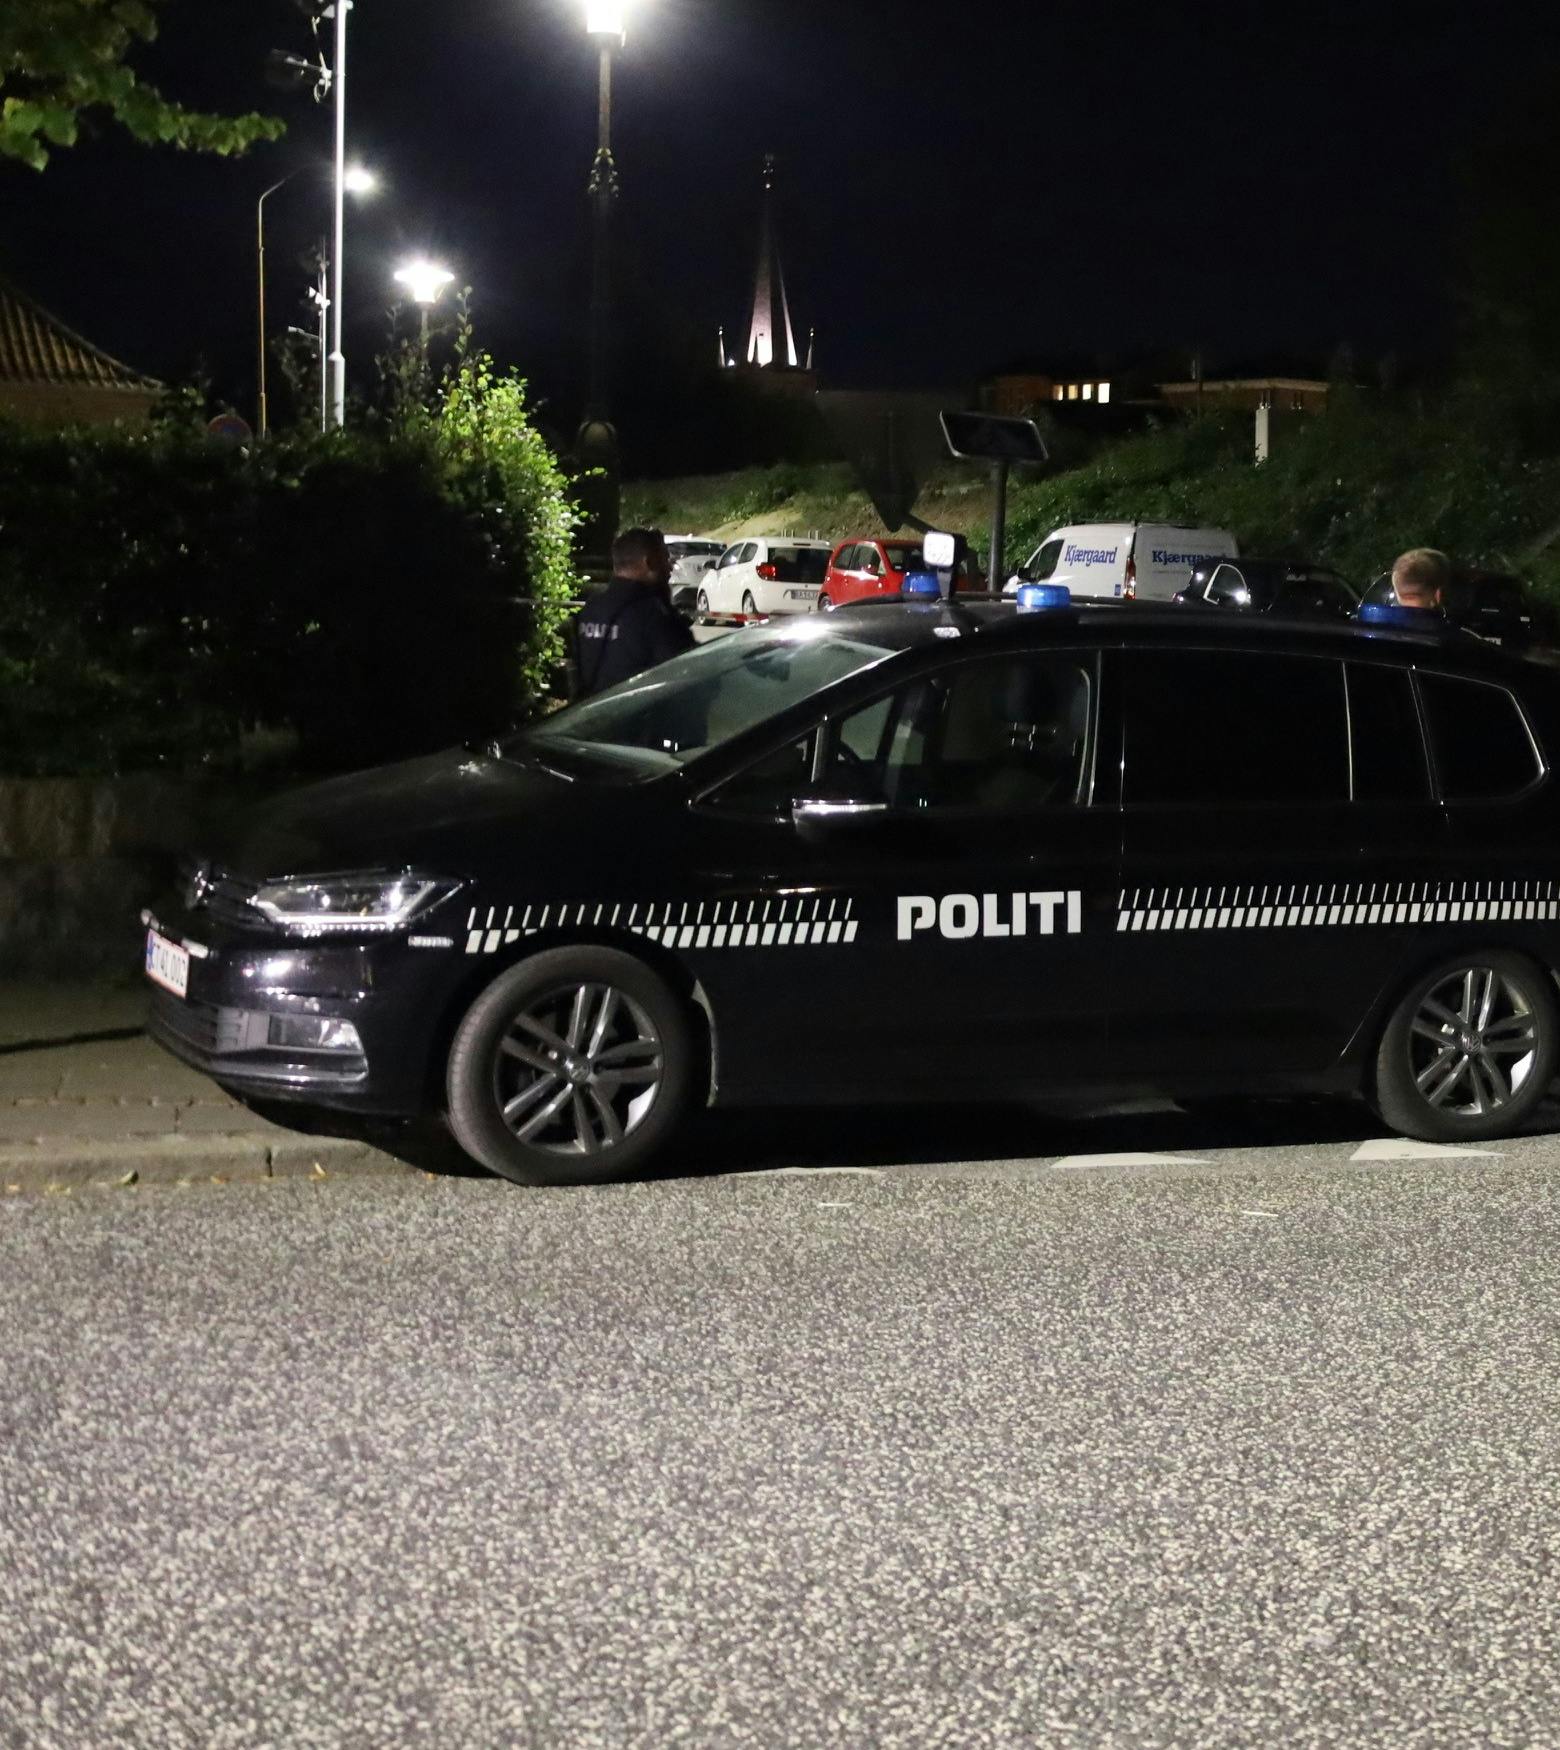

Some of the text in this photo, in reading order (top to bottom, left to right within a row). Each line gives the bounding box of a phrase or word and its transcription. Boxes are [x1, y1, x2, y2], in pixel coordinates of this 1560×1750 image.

[1064, 545, 1118, 567] Kjærgaard
[578, 622, 619, 640] POLII
[897, 890, 1082, 941] POLITI
